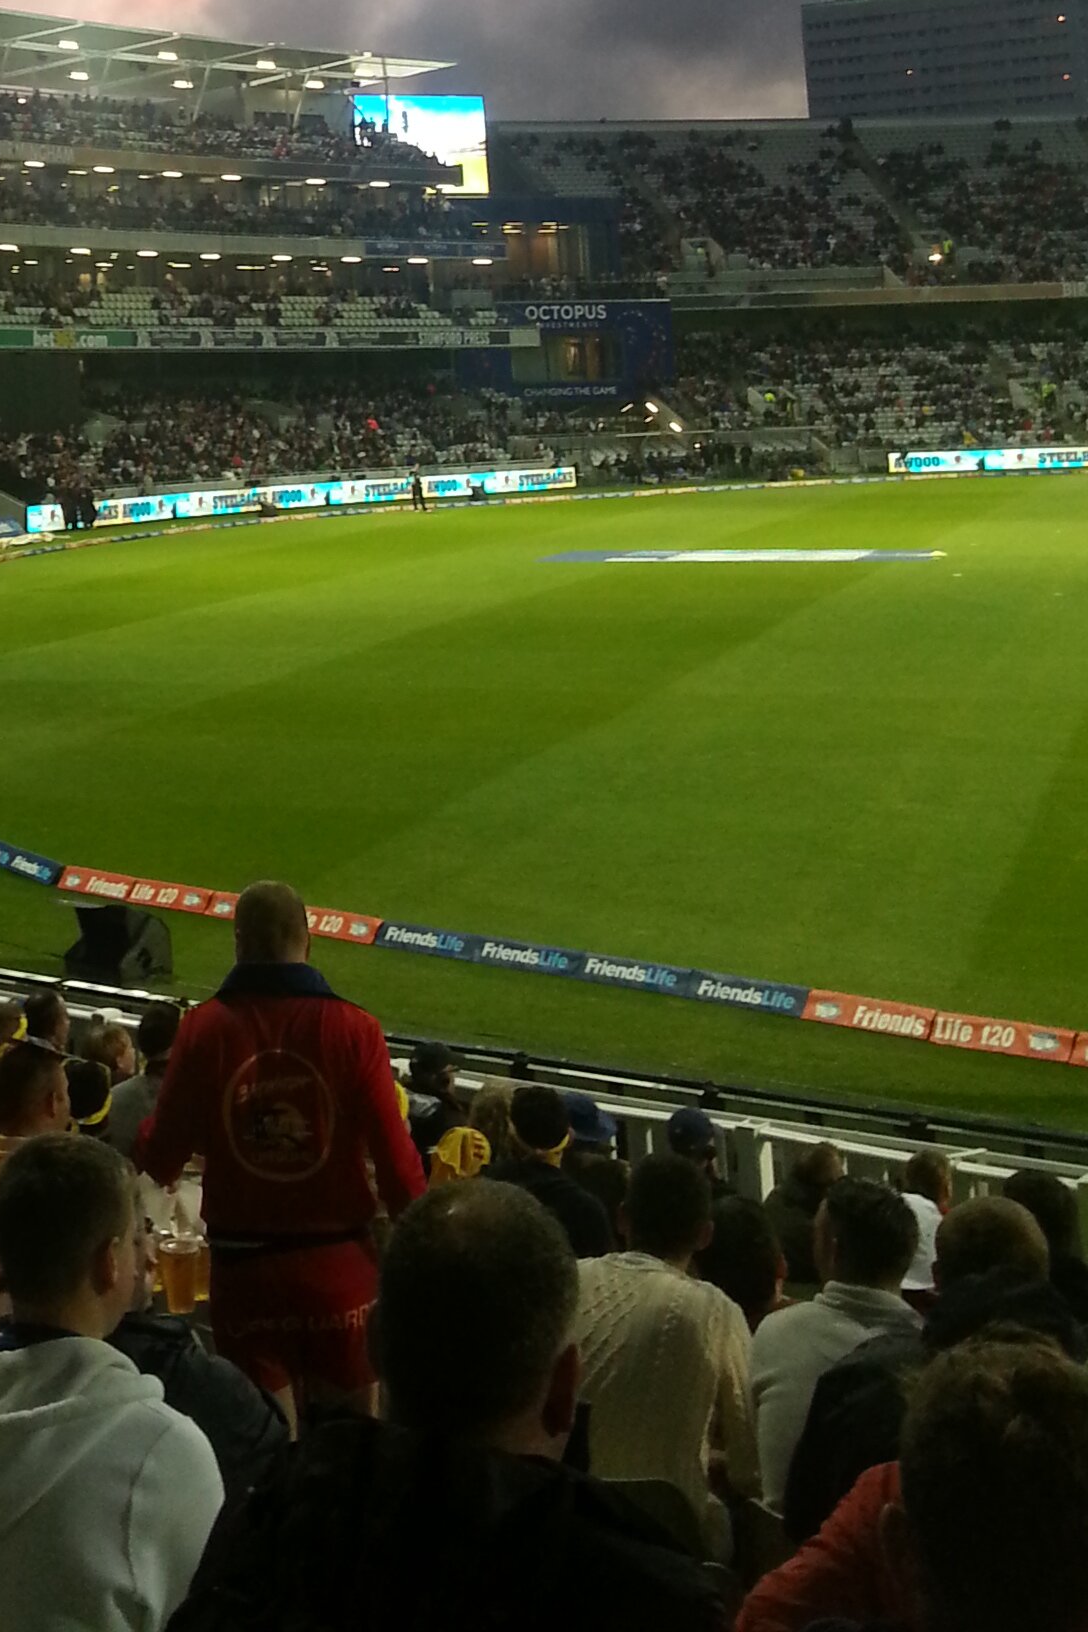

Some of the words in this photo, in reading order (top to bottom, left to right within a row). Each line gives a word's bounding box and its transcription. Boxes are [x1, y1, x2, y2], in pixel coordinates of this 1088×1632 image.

[525, 304, 607, 320] OCTOPUS
[84, 876, 129, 899] Friends
[130, 882, 155, 902] Life
[852, 1006, 926, 1036] Friends
[934, 1018, 973, 1042] Life
[979, 1025, 1015, 1048] t20
